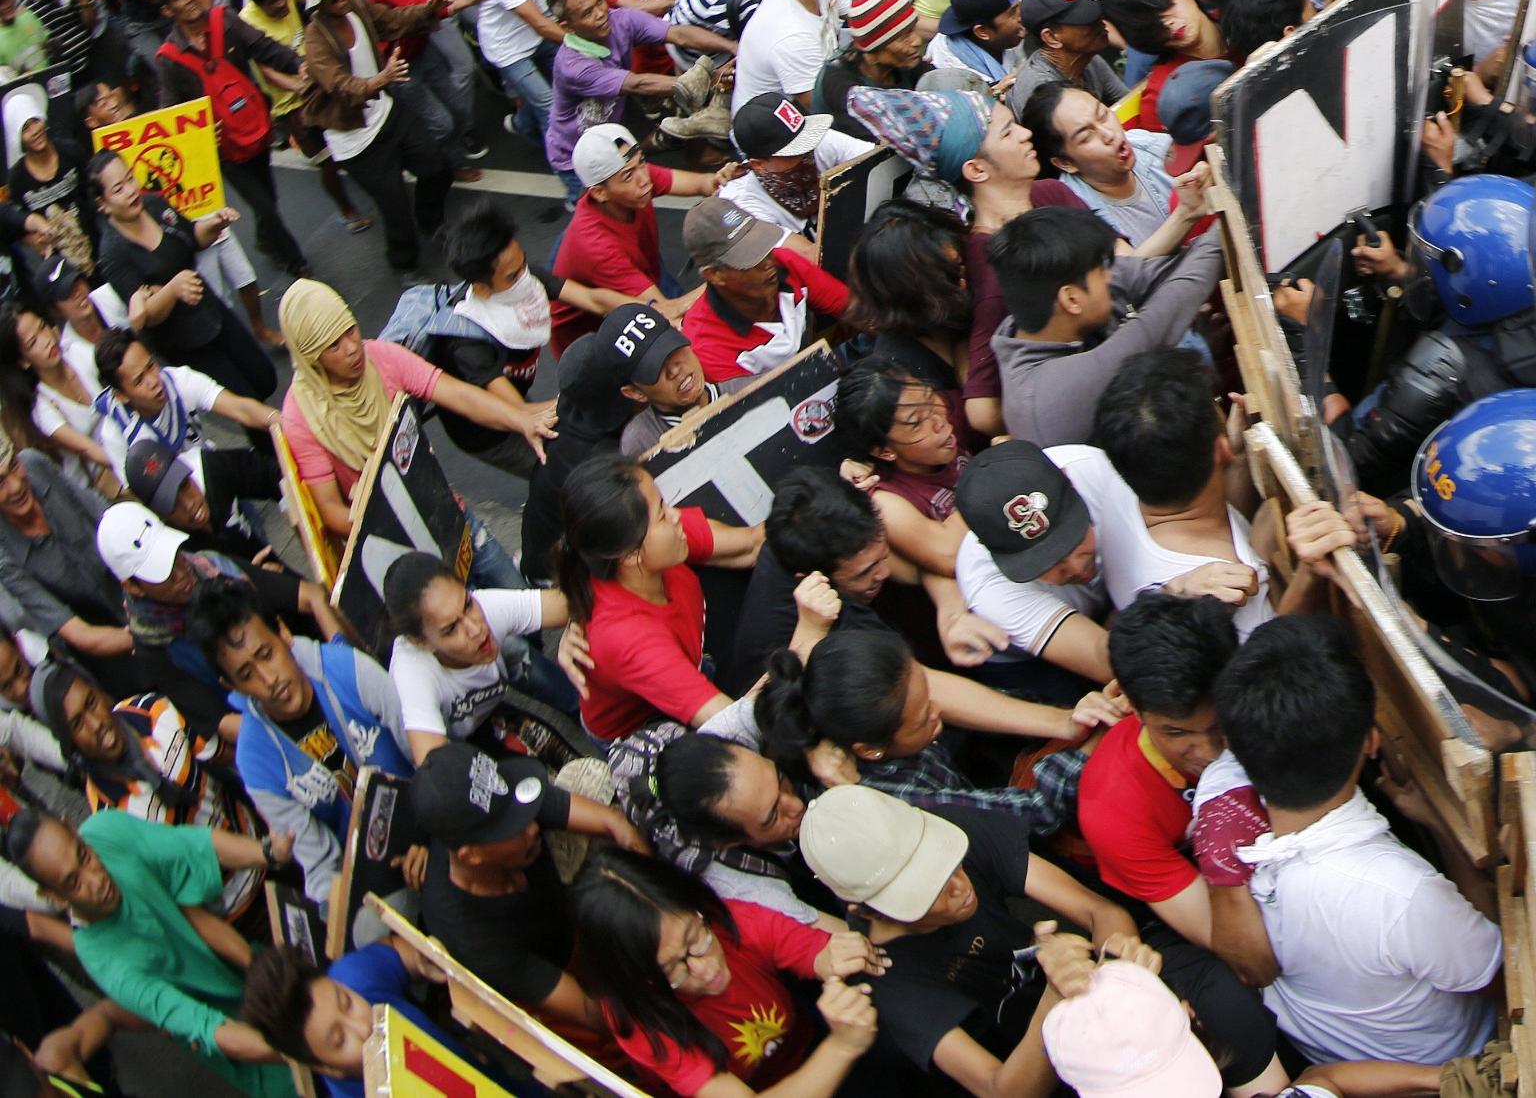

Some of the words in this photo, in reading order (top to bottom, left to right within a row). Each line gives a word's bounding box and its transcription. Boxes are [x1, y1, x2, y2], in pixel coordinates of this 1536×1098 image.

[101, 108, 209, 152] BAN
[614, 313, 656, 358] BTS
[653, 395, 792, 527] T
